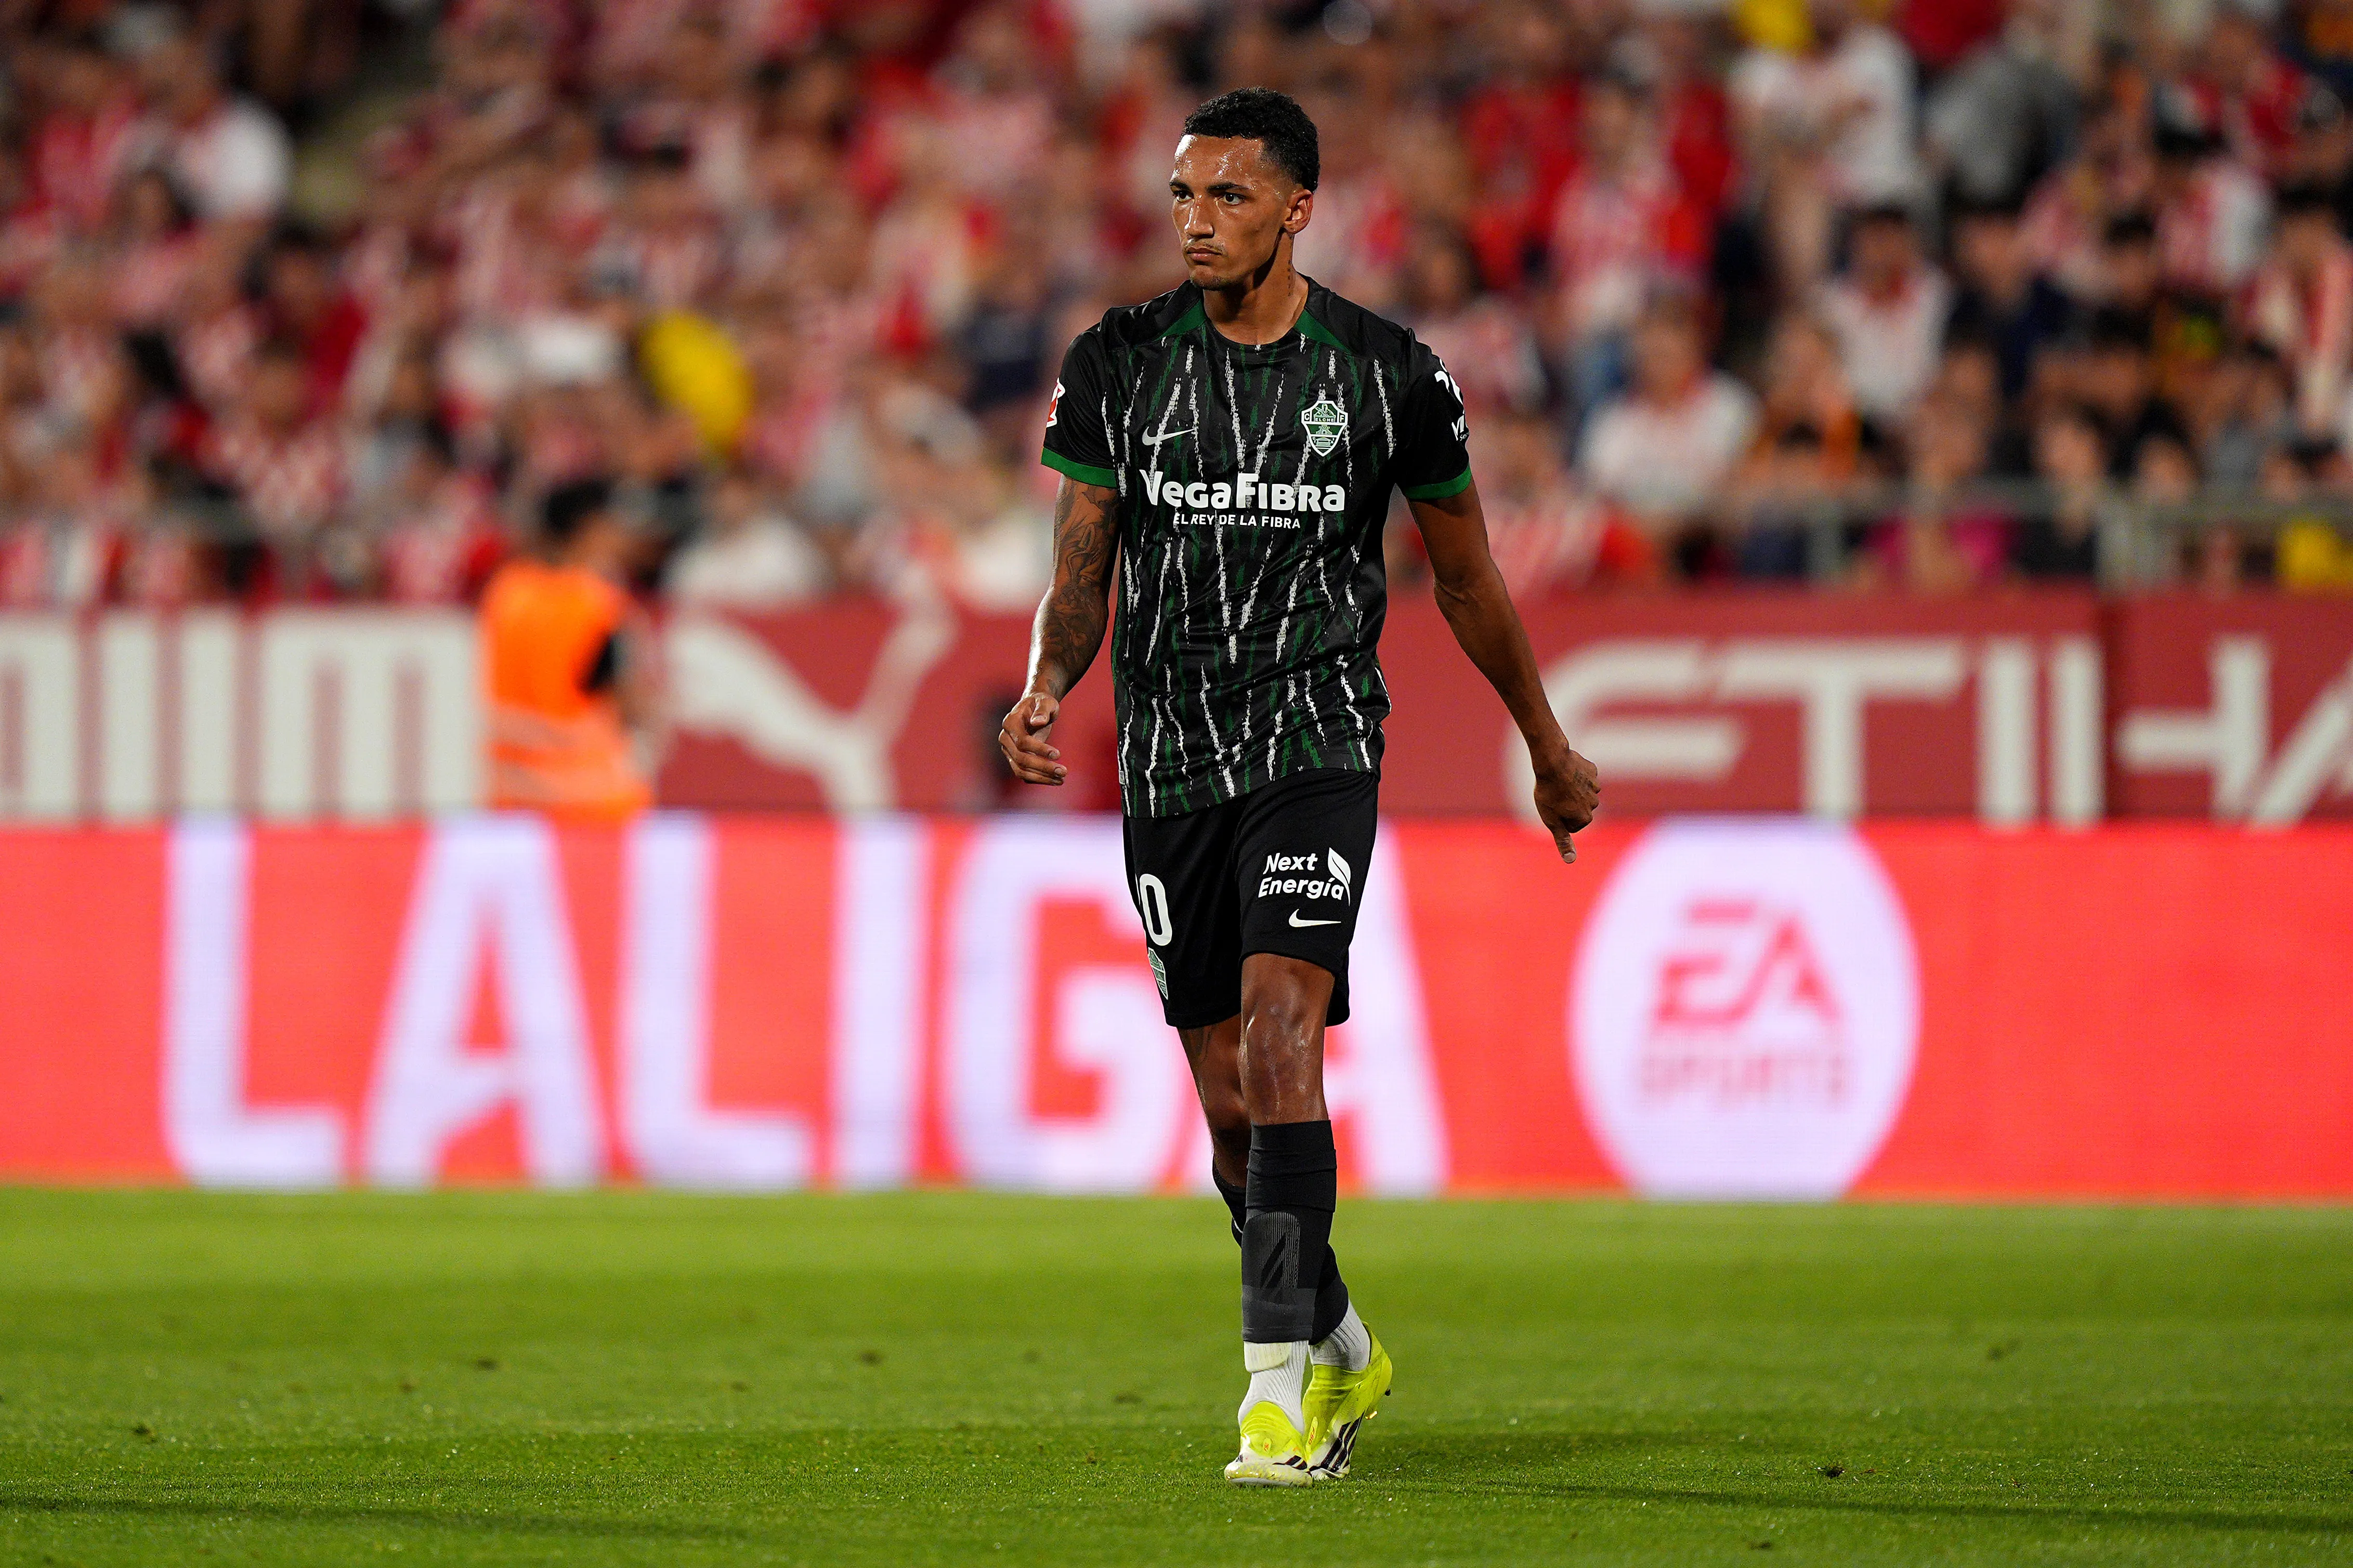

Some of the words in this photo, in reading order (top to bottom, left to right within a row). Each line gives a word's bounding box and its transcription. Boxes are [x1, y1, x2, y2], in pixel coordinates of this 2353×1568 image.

[1174, 514, 1187, 524] EL
[1191, 514, 1215, 525] REY
[1219, 514, 1236, 525] DE
[1239, 516, 1257, 526] LA
[1262, 516, 1301, 529] FIBRA
[1263, 852, 1318, 875] Next
[1258, 877, 1344, 900] Energía
[1652, 897, 1843, 1032] EA
[164, 817, 1448, 1191] LALIGA
